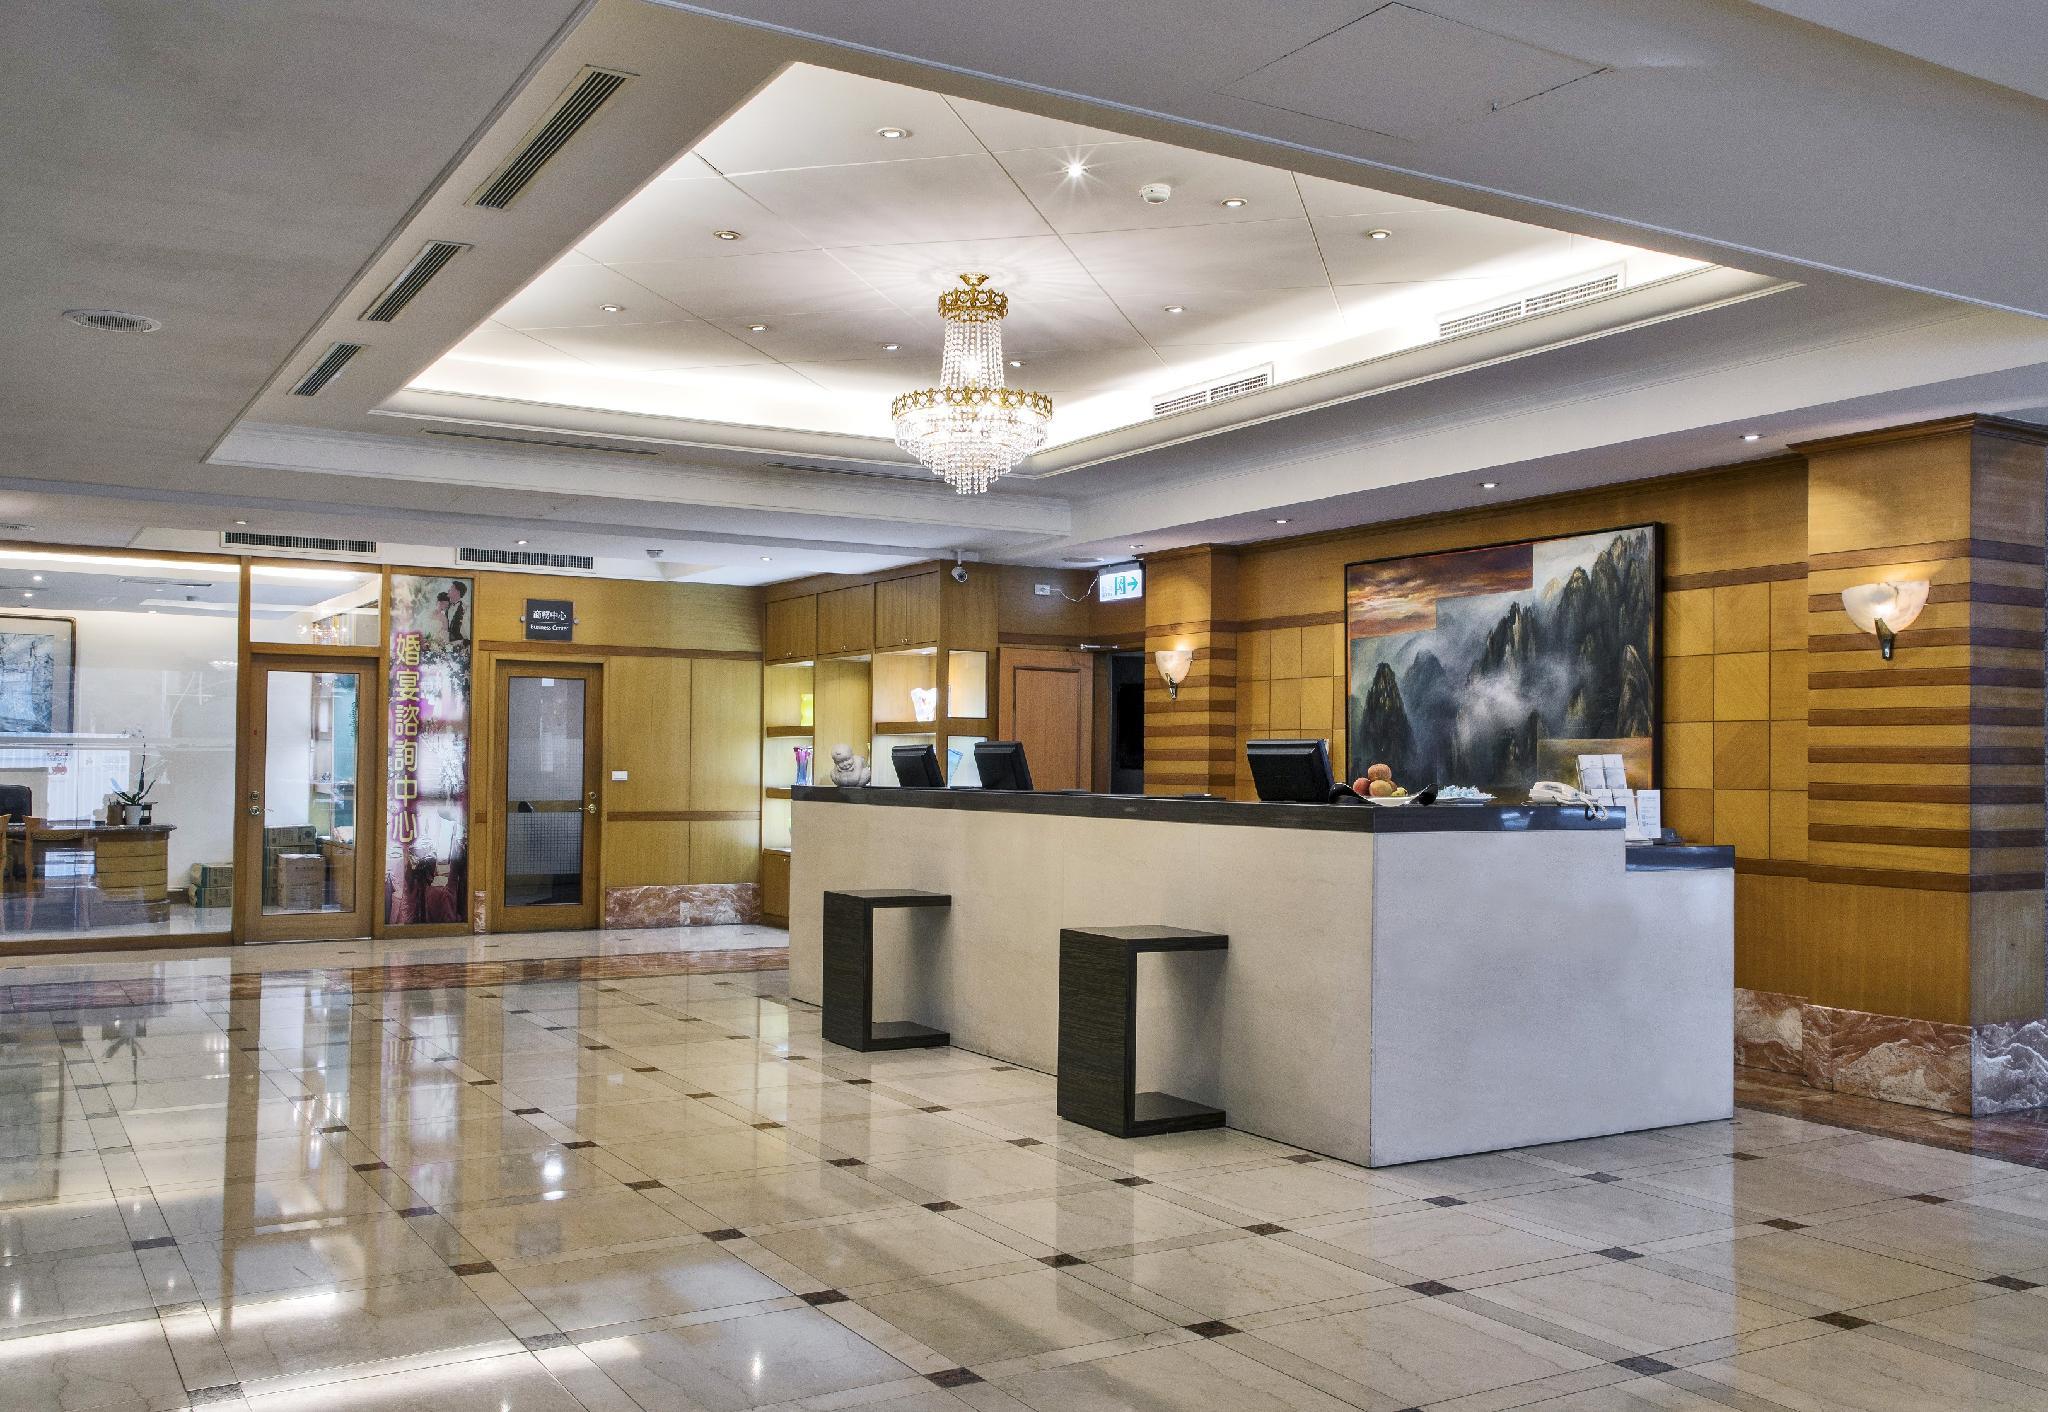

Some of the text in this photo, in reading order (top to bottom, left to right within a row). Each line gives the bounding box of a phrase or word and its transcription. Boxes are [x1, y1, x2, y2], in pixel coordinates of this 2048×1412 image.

[532, 609, 567, 621] 商務中心
[393, 633, 421, 843] 婚宴諮詢中心
